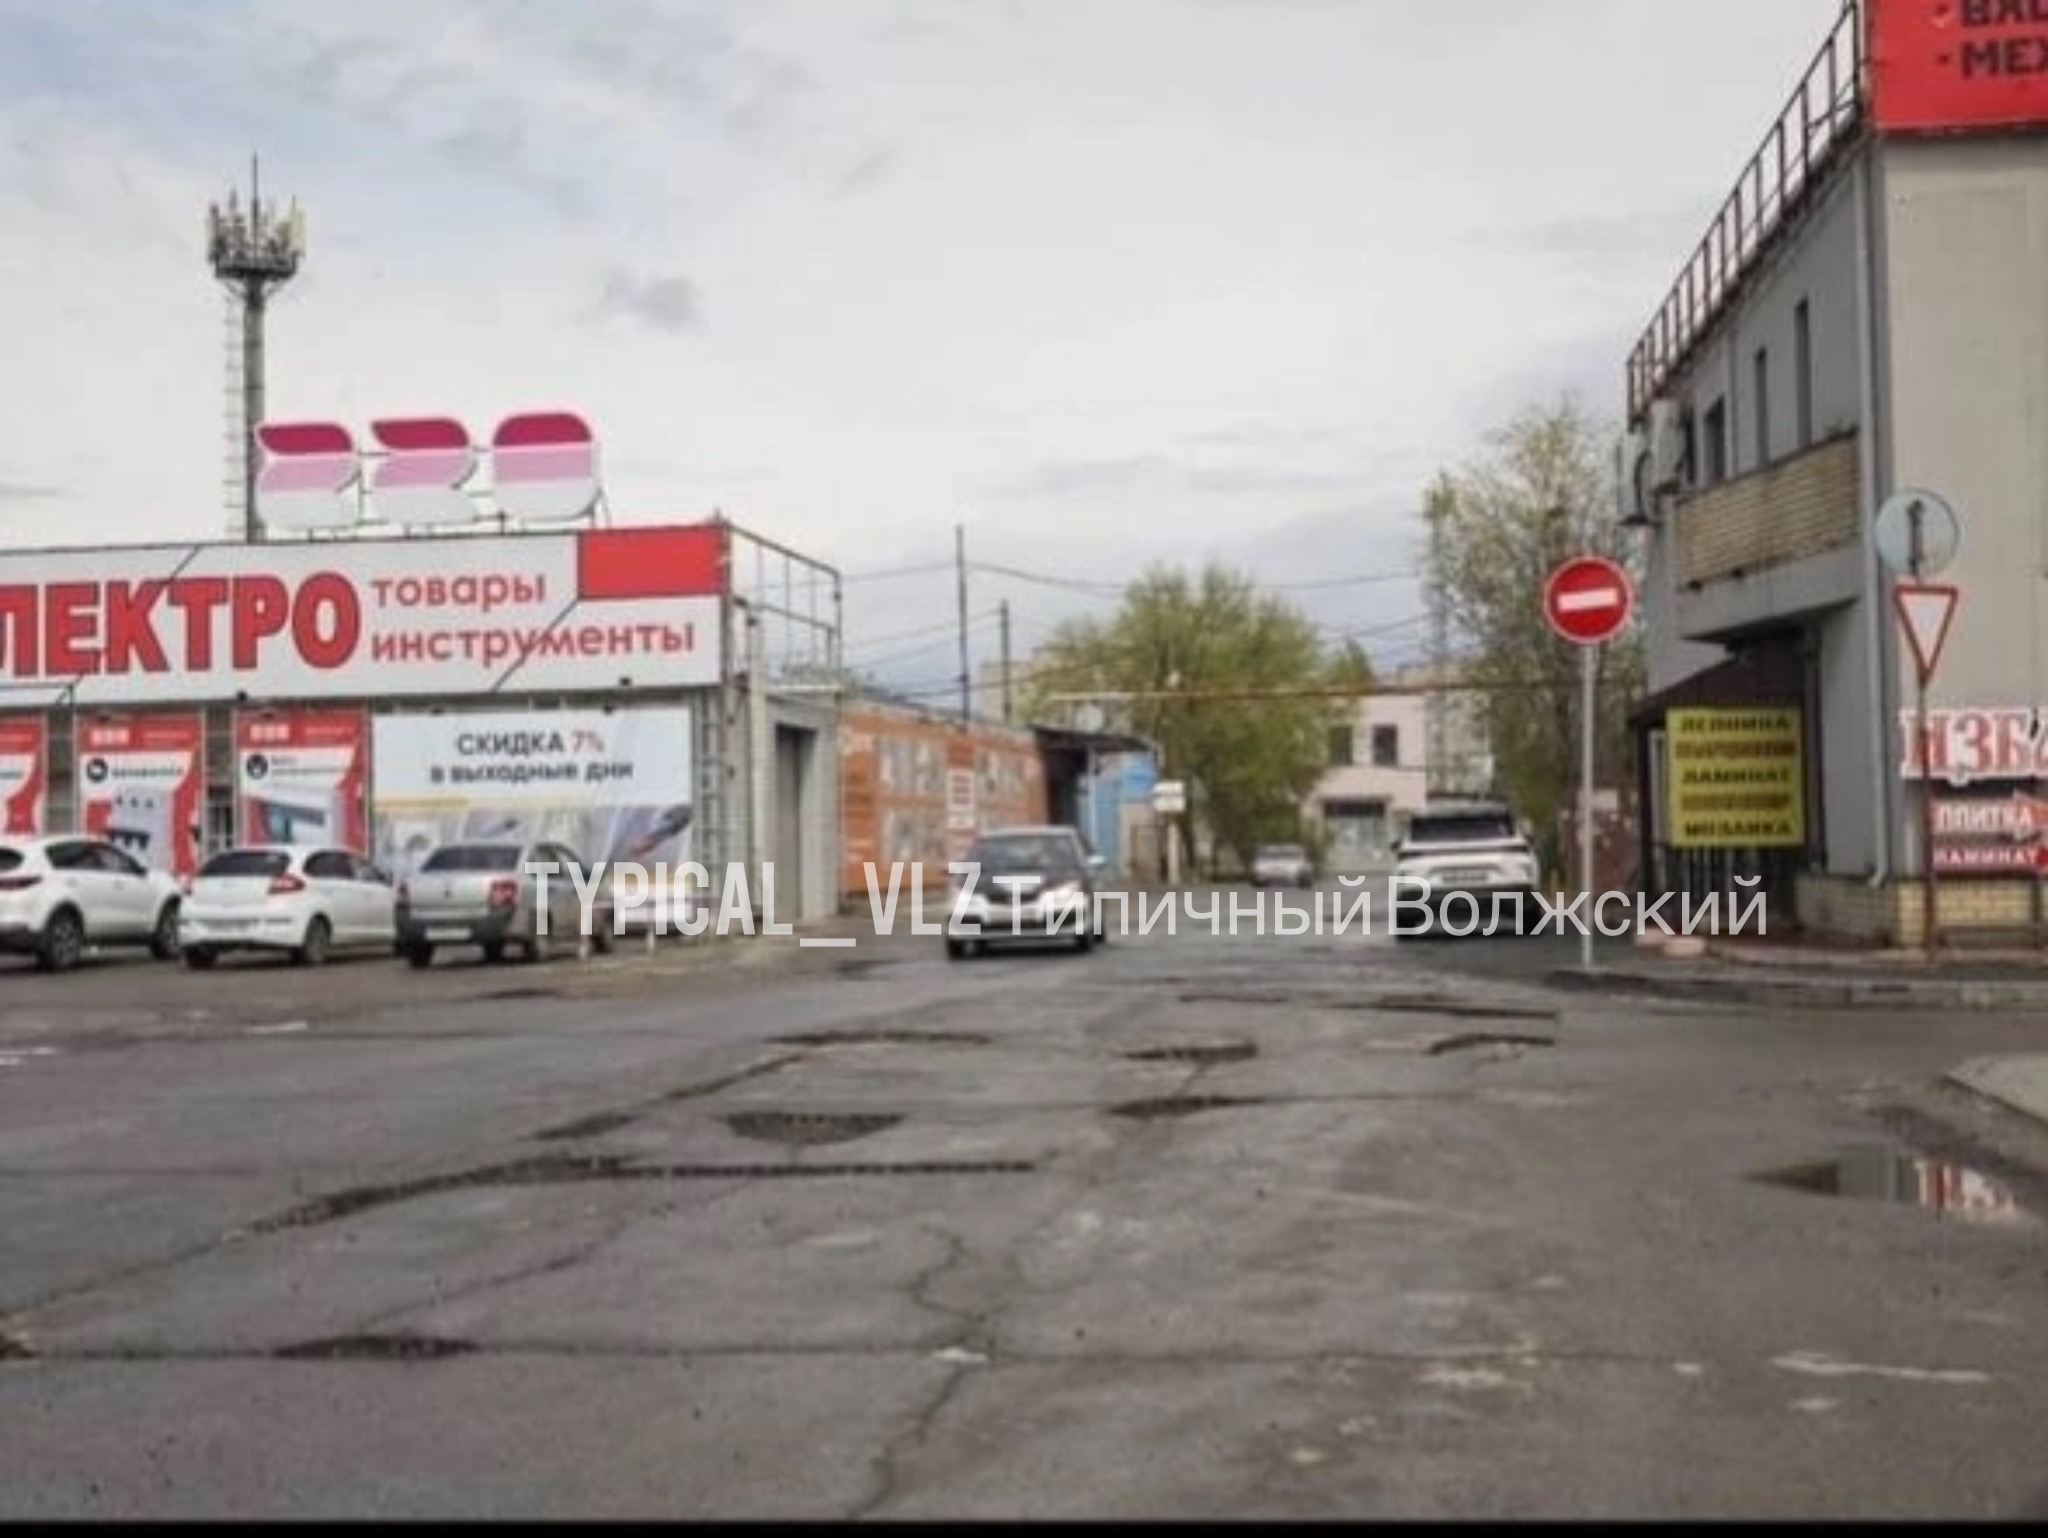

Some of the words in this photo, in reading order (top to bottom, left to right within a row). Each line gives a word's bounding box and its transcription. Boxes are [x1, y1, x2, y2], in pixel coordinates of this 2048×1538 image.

[371, 573, 546, 613] товары
[371, 622, 695, 668] инструменты
[456, 730, 564, 757] СКИДКА
[574, 729, 604, 752] 7%
